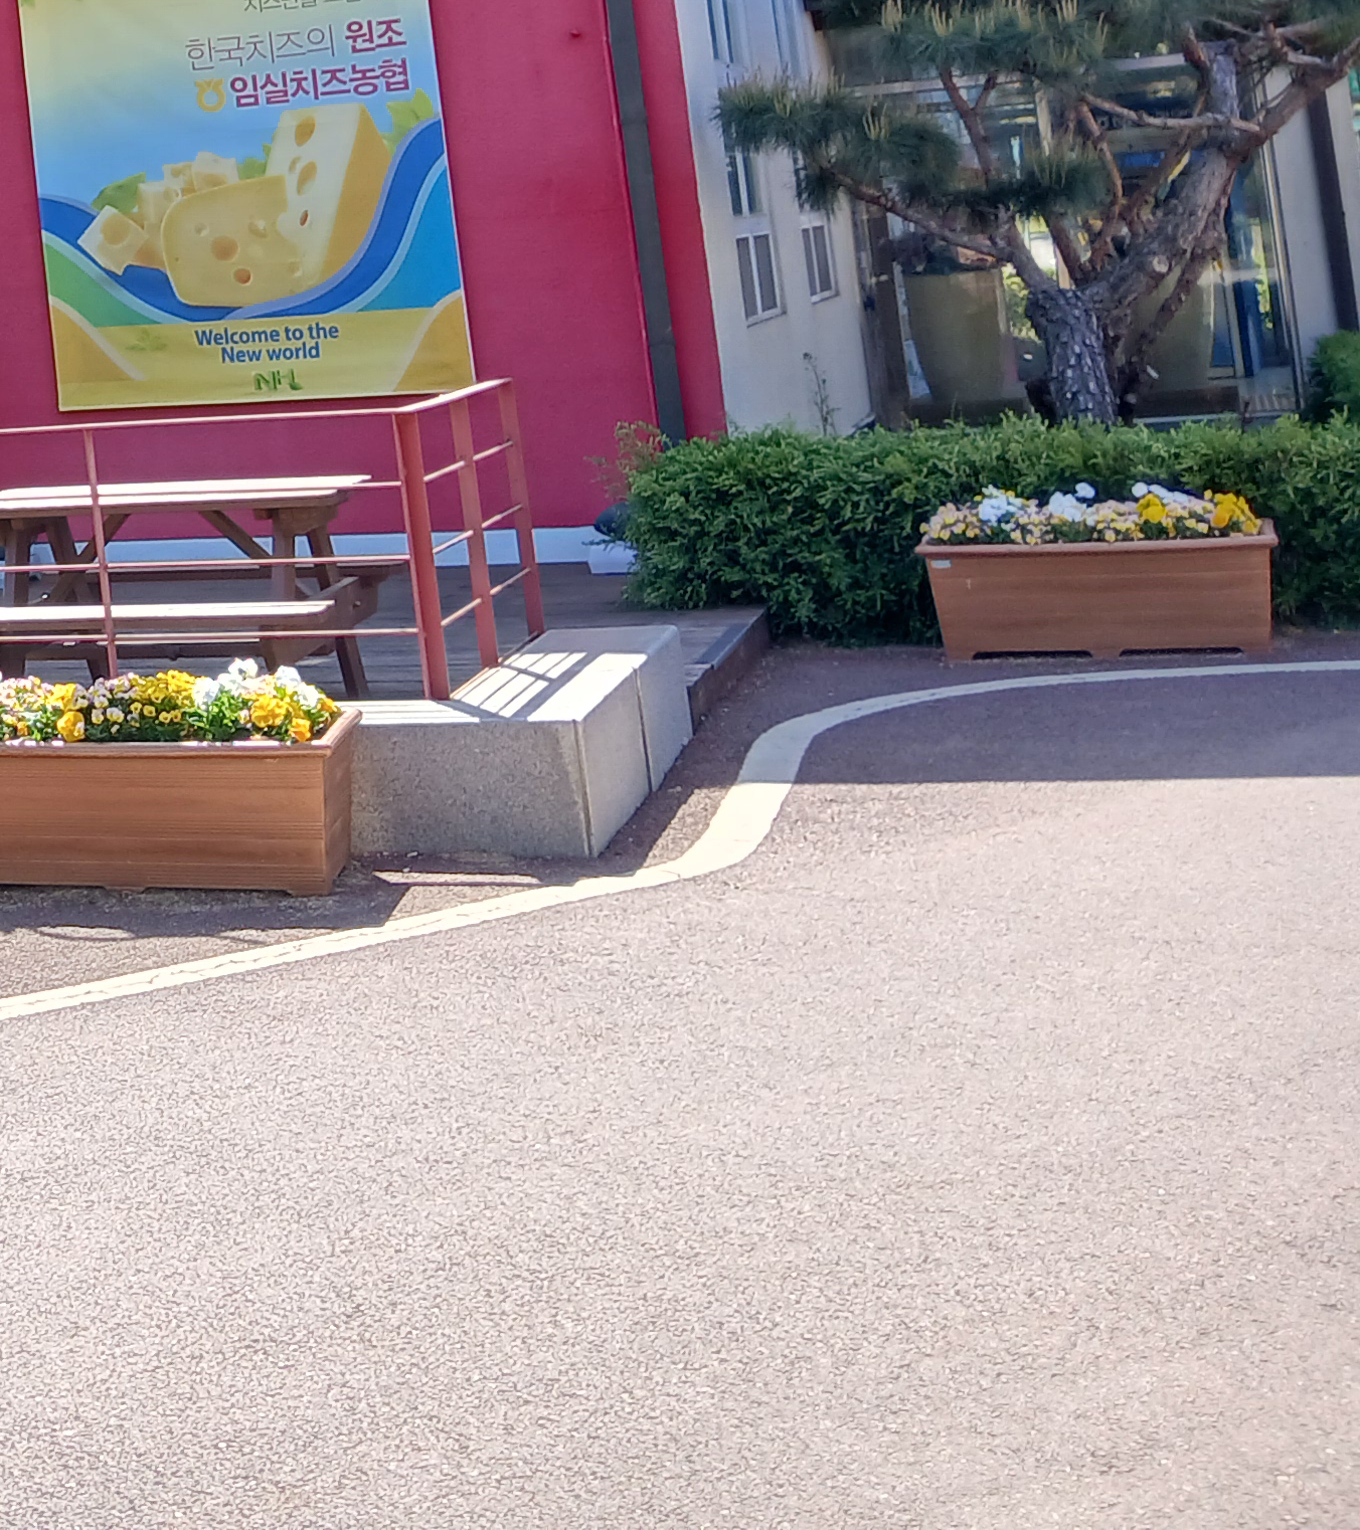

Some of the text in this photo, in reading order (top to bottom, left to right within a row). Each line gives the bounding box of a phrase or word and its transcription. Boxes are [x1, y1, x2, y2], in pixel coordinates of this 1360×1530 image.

[185, 18, 407, 71] 한국치즈의 원조
[230, 57, 410, 108] 임실치즈농협
[194, 322, 339, 346] Welcome to the
[221, 341, 320, 364] New world
